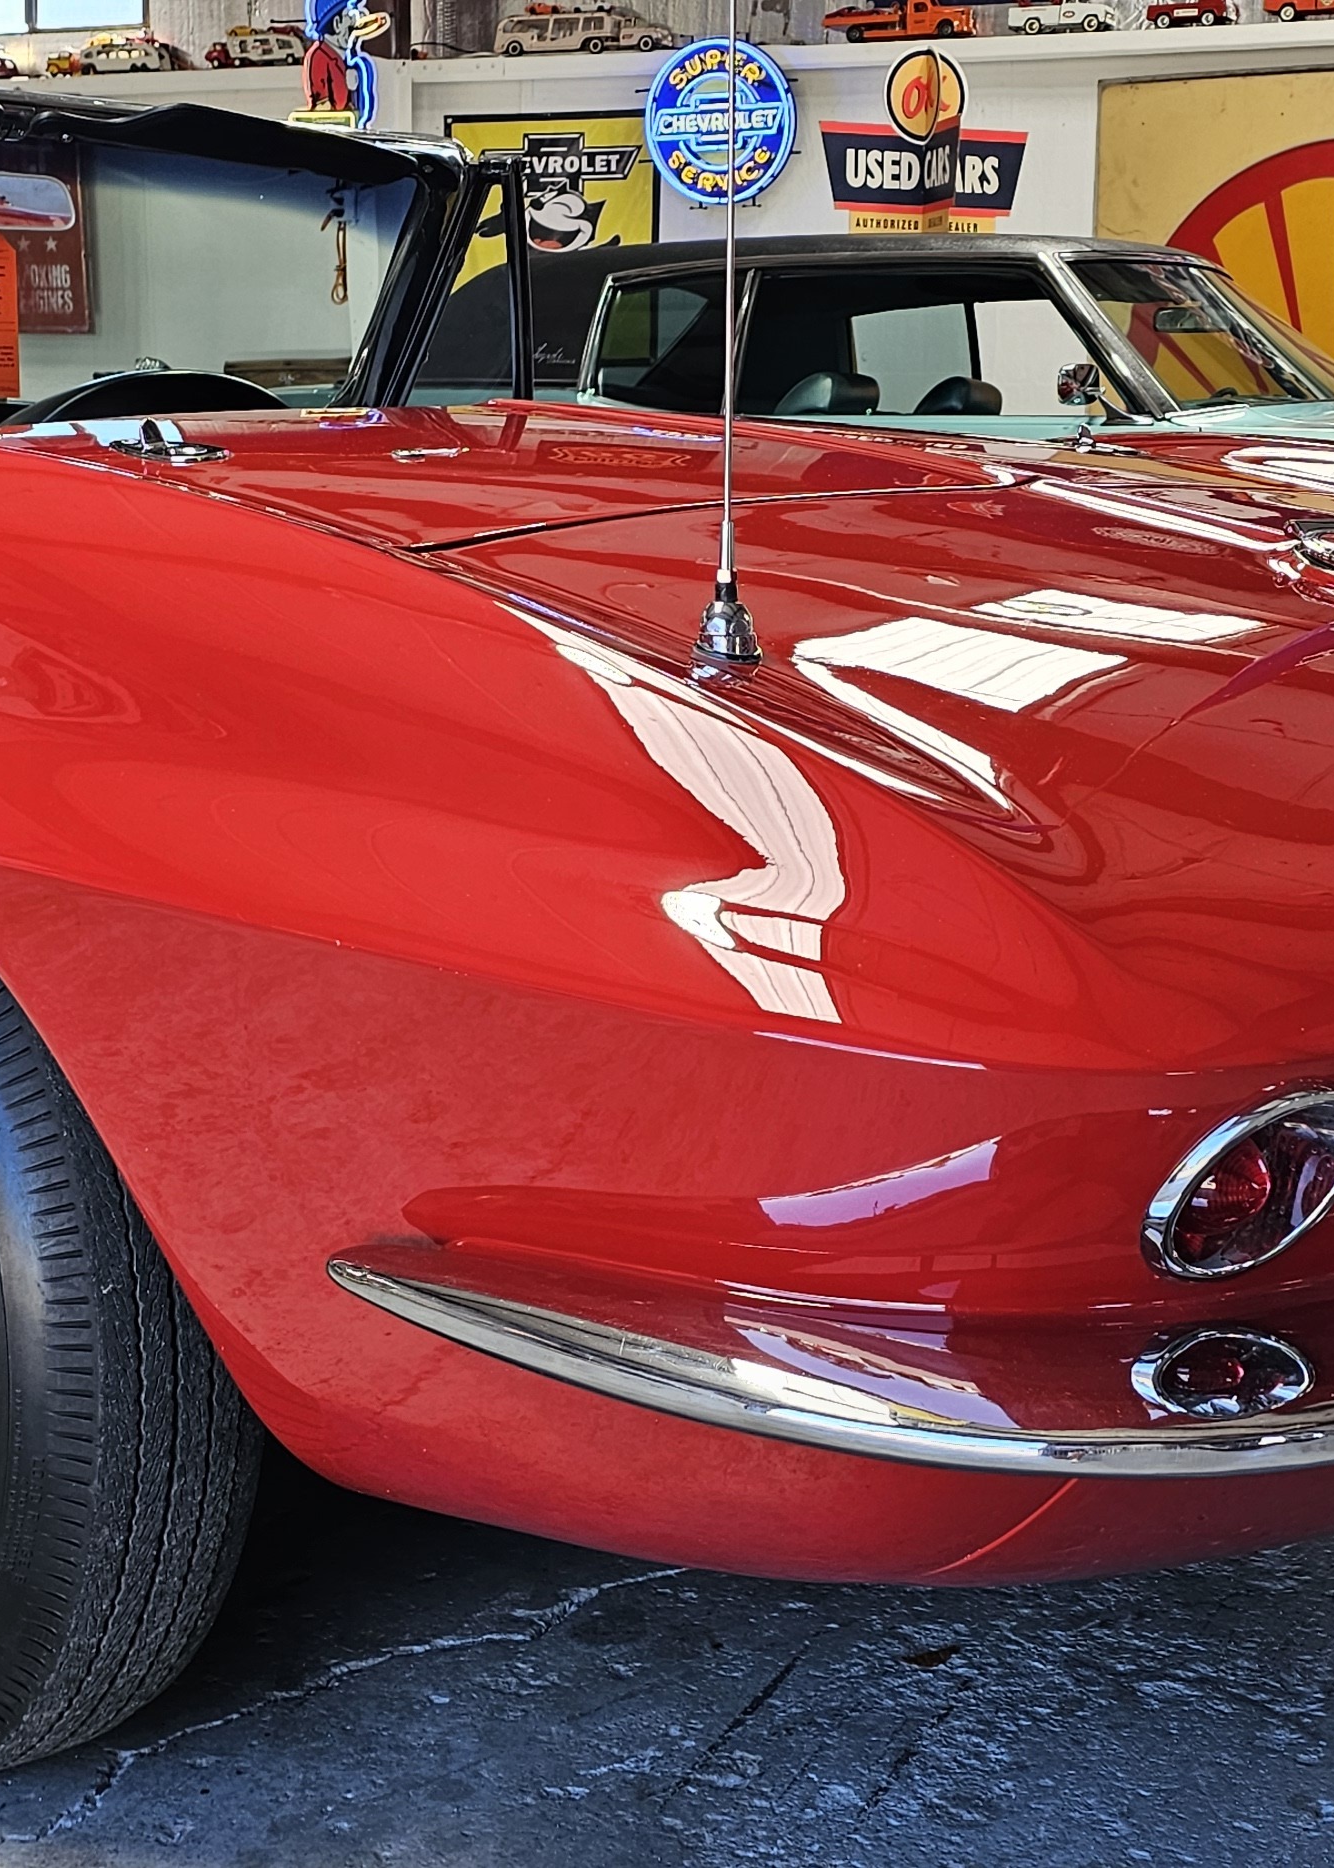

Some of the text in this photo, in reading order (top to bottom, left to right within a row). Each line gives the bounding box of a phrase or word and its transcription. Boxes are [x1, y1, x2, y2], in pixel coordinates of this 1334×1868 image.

[669, 49, 766, 90] SUPER
[658, 109, 778, 134] CHEVROLET
[522, 154, 620, 174] EVROLET
[668, 146, 771, 192] SERVICE
[845, 145, 951, 190] USED CARS
[956, 155, 1000, 195] ARS
[855, 217, 919, 231] AUTHORIZED
[948, 221, 978, 233] EALER
